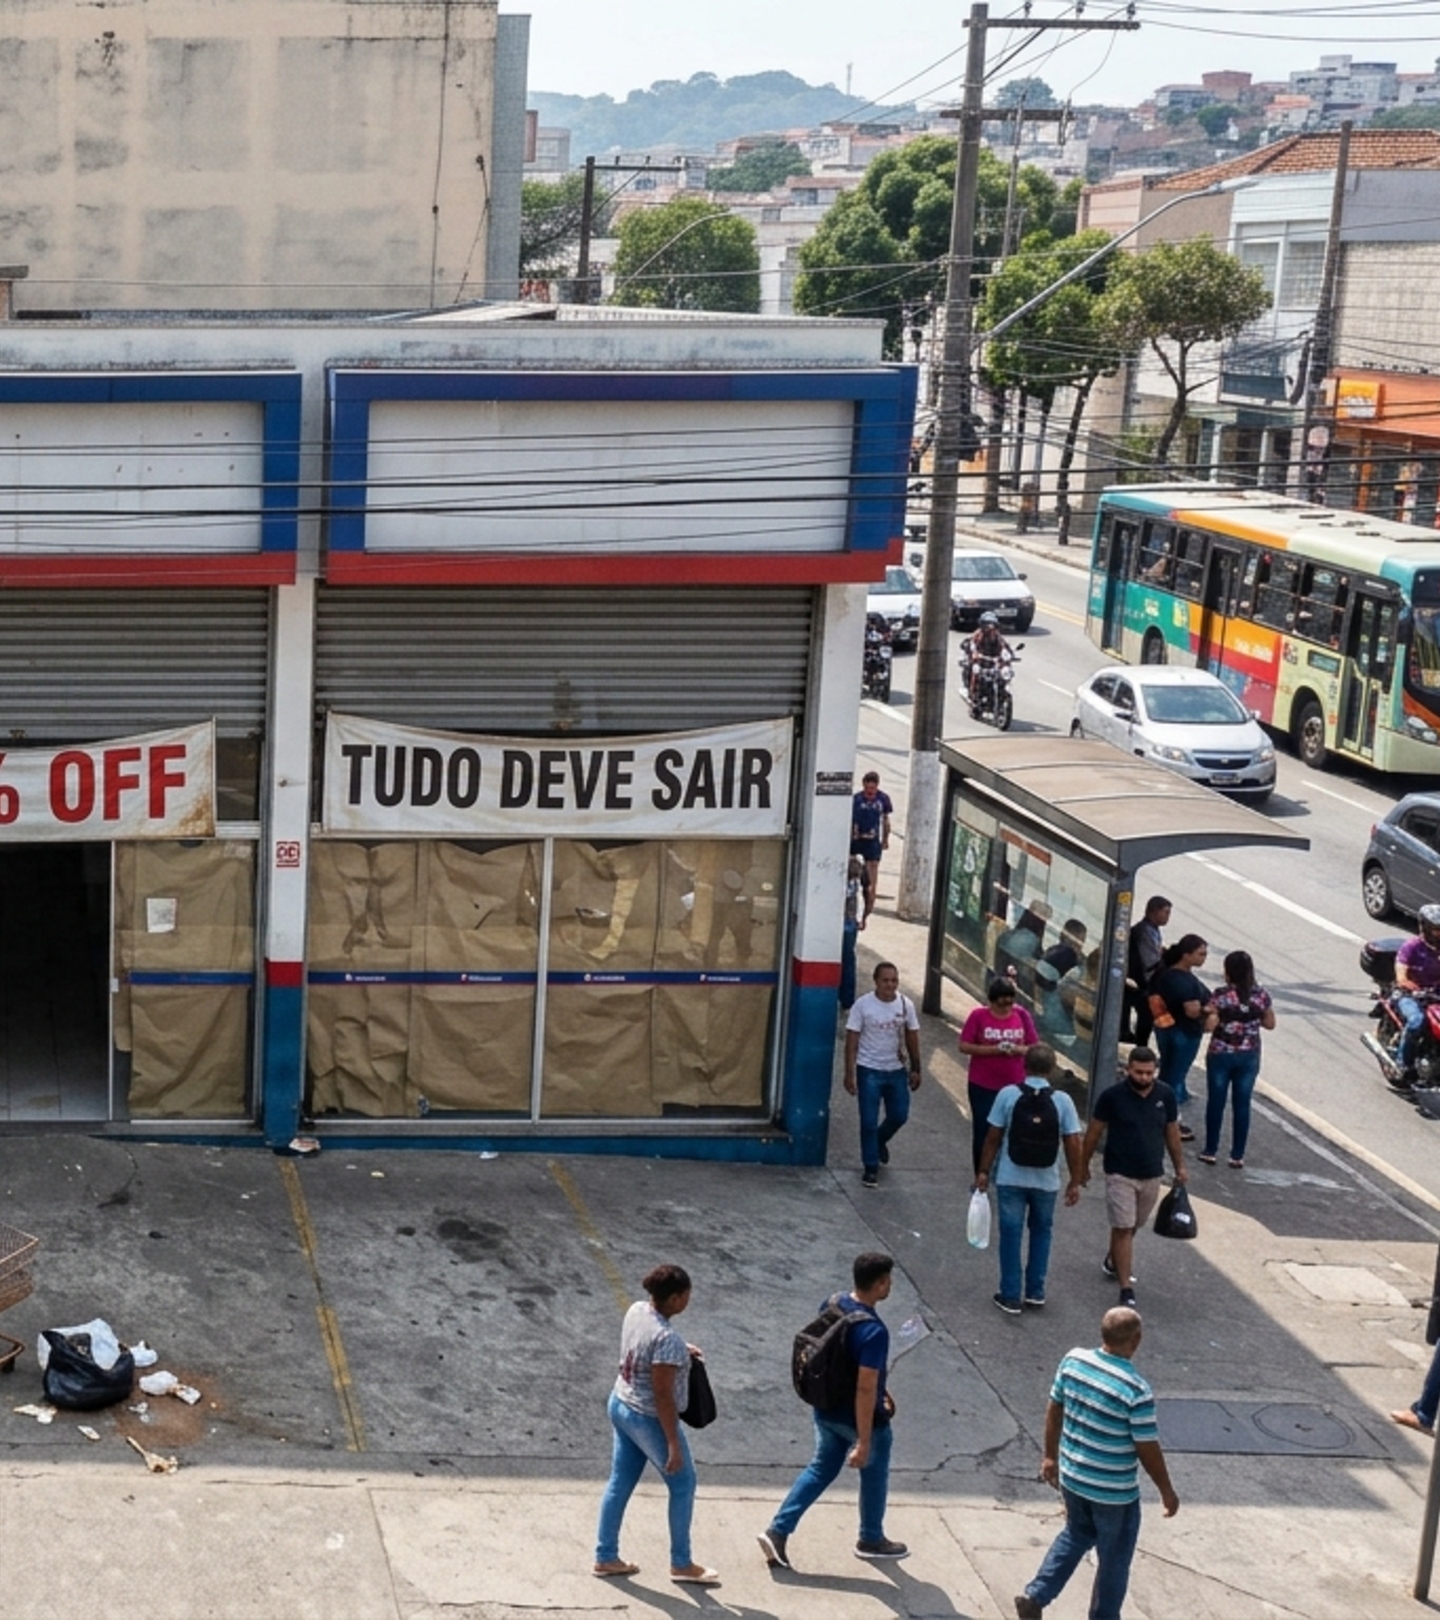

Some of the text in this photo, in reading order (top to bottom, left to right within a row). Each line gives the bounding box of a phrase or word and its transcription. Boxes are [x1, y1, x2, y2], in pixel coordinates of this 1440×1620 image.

[49, 744, 186, 823] OFF
[341, 744, 773, 811] TUDO DEVE SAIR
